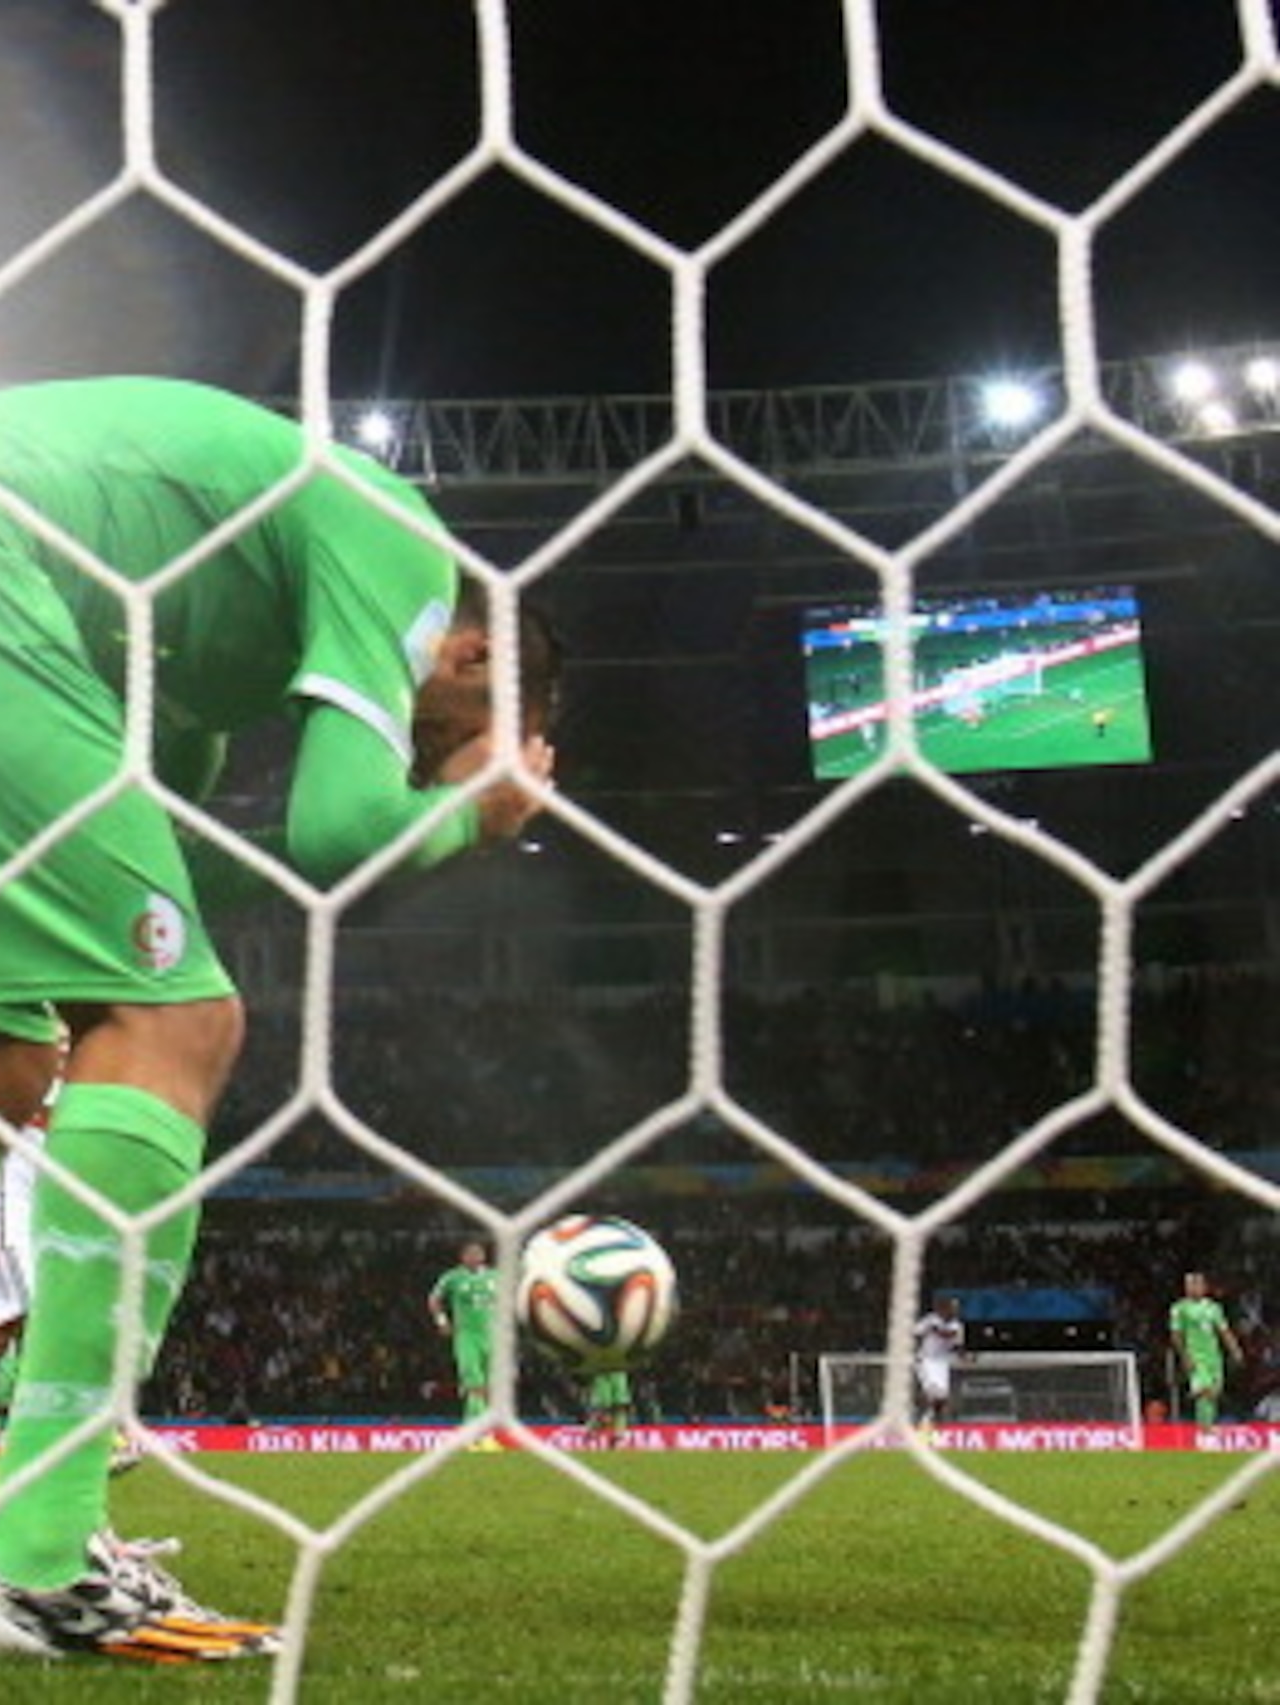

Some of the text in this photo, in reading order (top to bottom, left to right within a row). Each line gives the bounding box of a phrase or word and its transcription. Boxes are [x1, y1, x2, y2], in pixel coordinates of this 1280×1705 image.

[310, 1430, 360, 1452] KIA
[677, 1429, 808, 1452] MOTORS
[996, 1428, 1135, 1451] MOTORS
